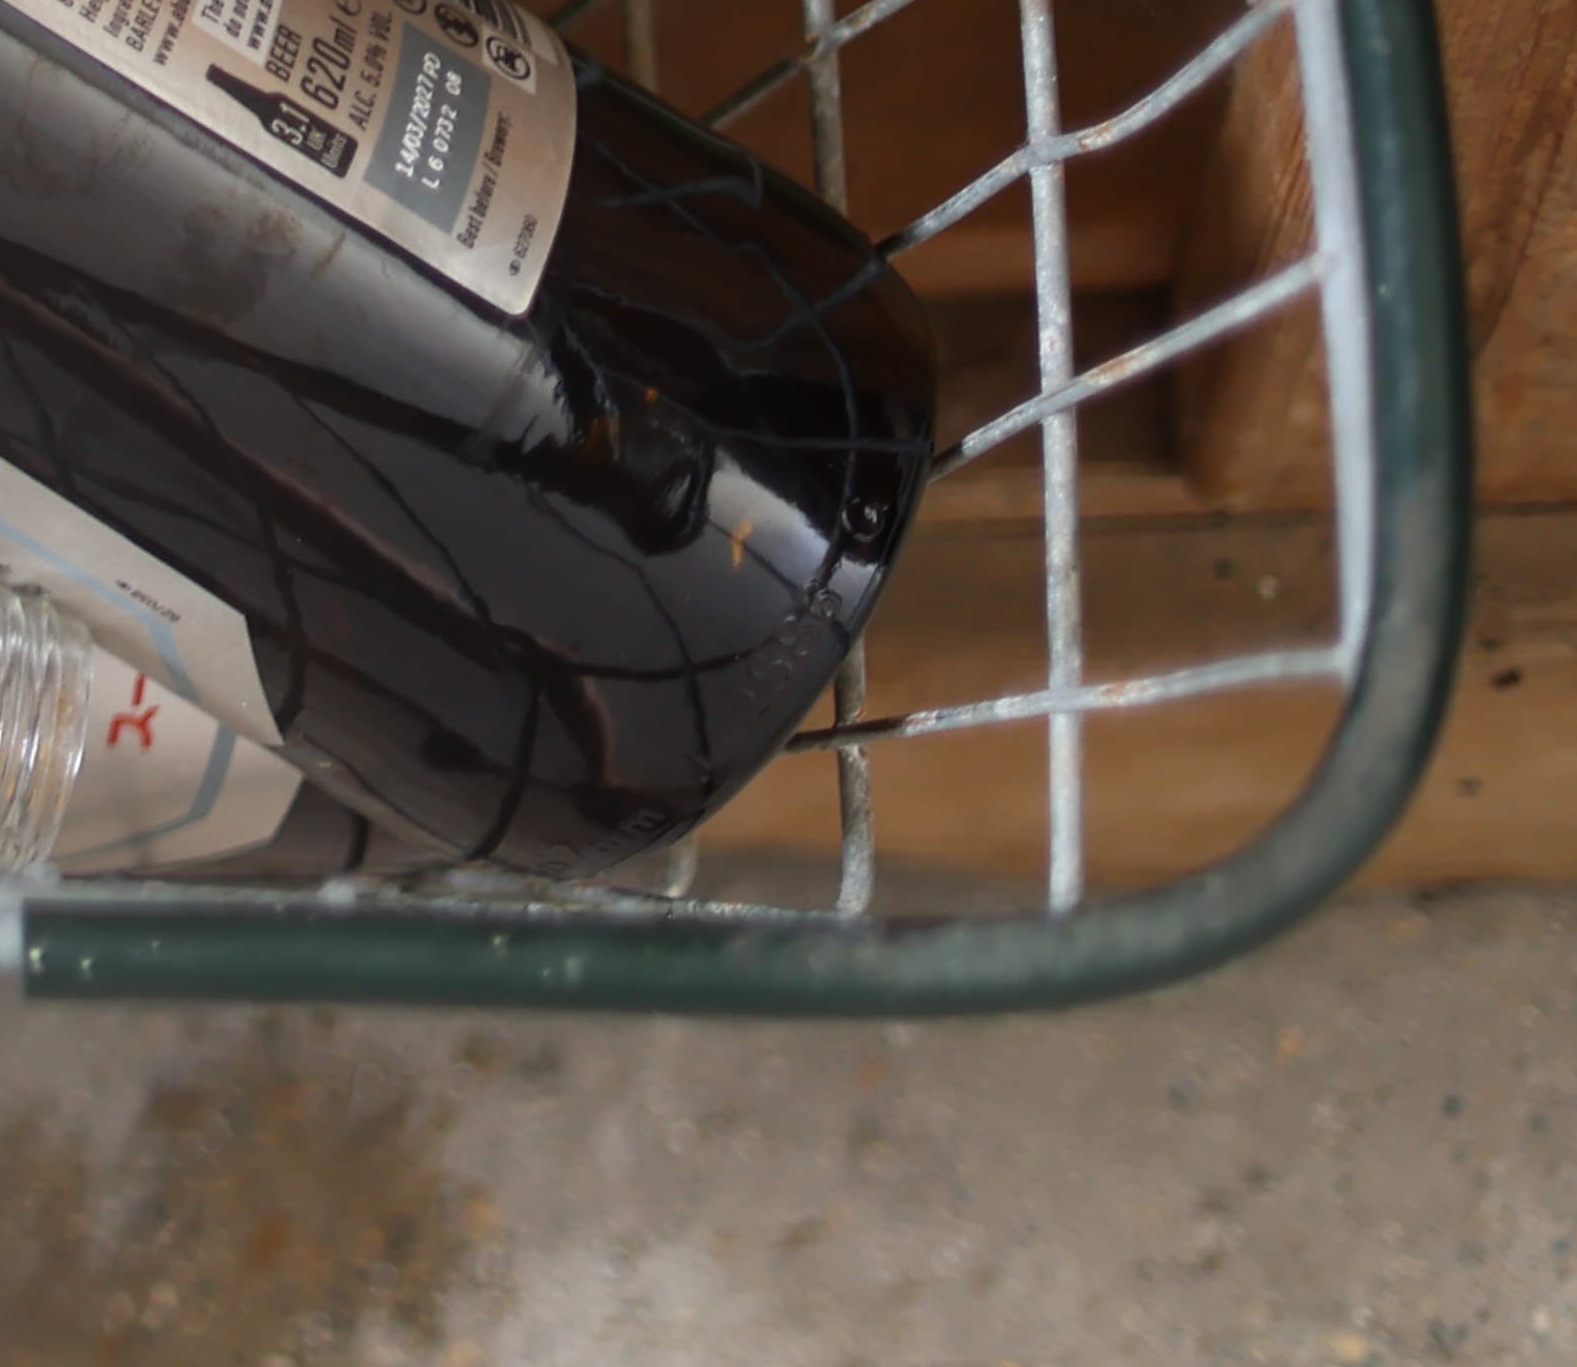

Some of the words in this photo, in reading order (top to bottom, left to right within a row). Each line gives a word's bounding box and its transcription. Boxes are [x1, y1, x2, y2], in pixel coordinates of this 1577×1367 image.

[265, 22, 302, 82] BEER
[300, 15, 356, 110] 620ml
[360, 44, 387, 88] 5.0%
[445, 70, 462, 96] 08
[271, 102, 309, 145] 3.1
[348, 90, 377, 131] ALC.
[395, 74, 433, 177] 14/03/2027
[432, 104, 457, 153] 0732
[307, 127, 324, 151] UK
[421, 177, 440, 189] L
[427, 155, 444, 172] 6
